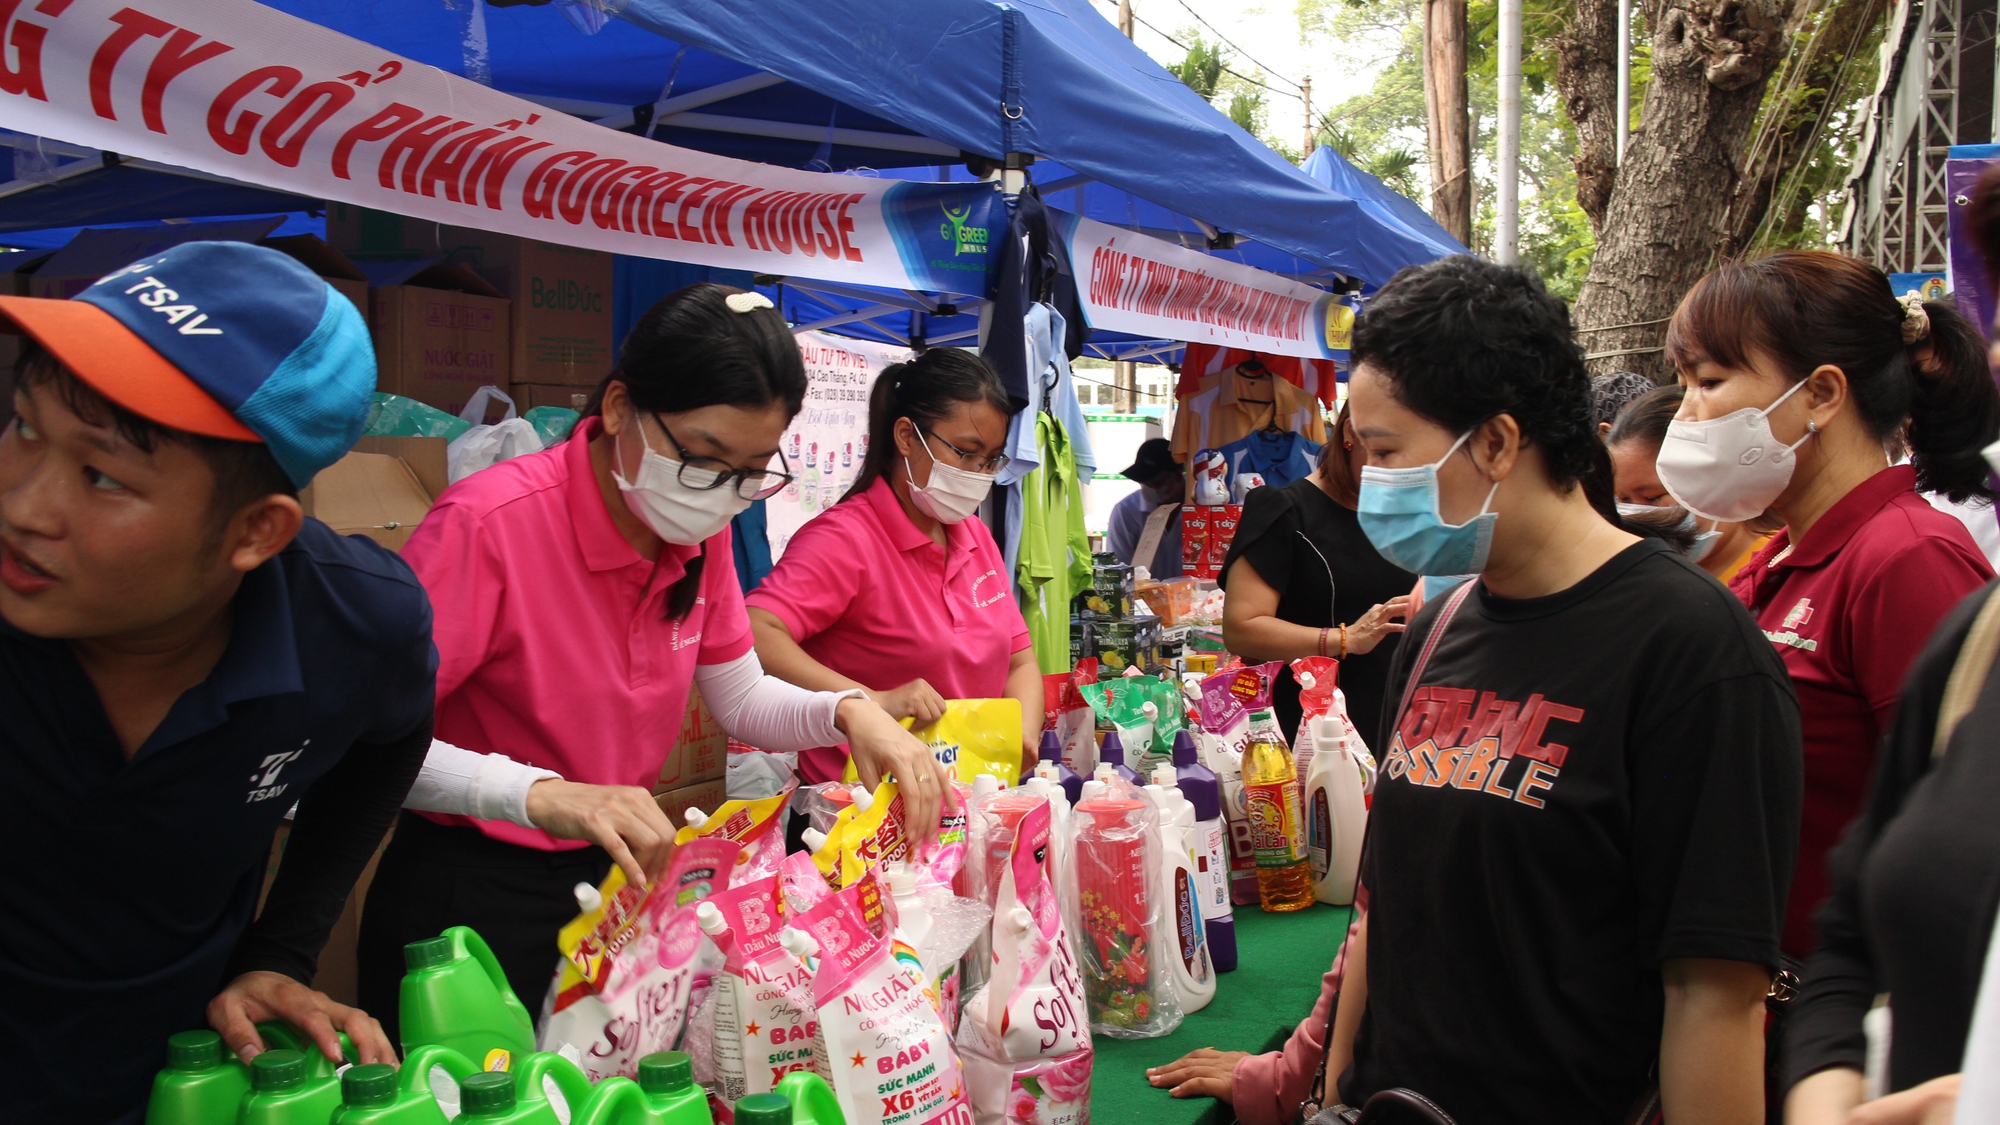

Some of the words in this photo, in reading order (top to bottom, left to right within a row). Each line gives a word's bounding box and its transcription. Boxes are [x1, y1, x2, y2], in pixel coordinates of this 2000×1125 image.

[89, 7, 235, 134] TY
[207, 61, 402, 167] CỔ
[332, 102, 553, 210] PHẦN
[522, 150, 753, 246] GOGREEN
[742, 187, 867, 262] HOUSE
[1090, 237, 1127, 309] CÔNG
[1122, 256, 1146, 312] TY
[1136, 260, 1176, 316] TNHH
[125, 276, 223, 335] TSAV
[531, 277, 602, 313] BellĐúc
[246, 783, 288, 803] TSAV
[770, 1020, 818, 1045] BAB
[768, 1050, 795, 1064] SỨC
[877, 1038, 930, 1074] BABY
[877, 1078, 904, 1094] SỨC
[906, 1062, 936, 1085] MẠNH
[881, 1089, 915, 1117] X6
[882, 1112, 911, 1125] TRONG
